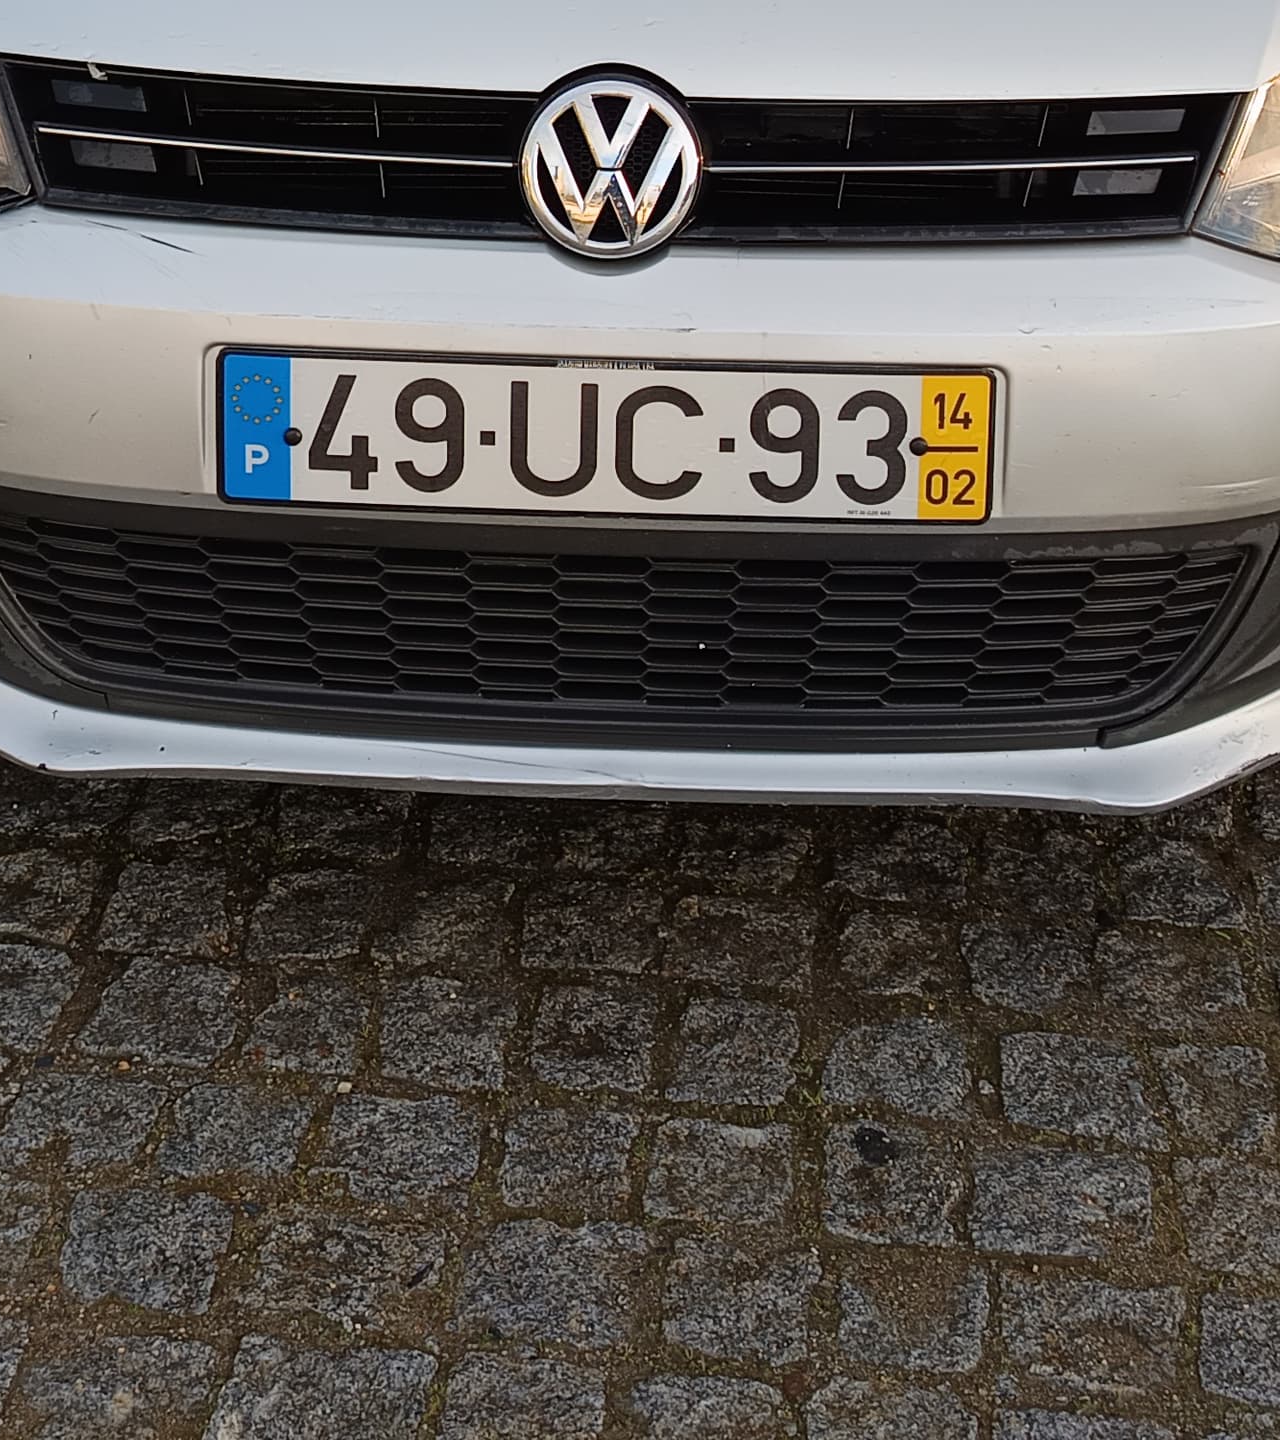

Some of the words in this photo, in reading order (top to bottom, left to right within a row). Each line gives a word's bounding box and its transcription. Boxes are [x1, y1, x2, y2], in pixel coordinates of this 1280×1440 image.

[933, 392, 973, 430] 14
[244, 443, 270, 474] P
[924, 468, 976, 506] 02
